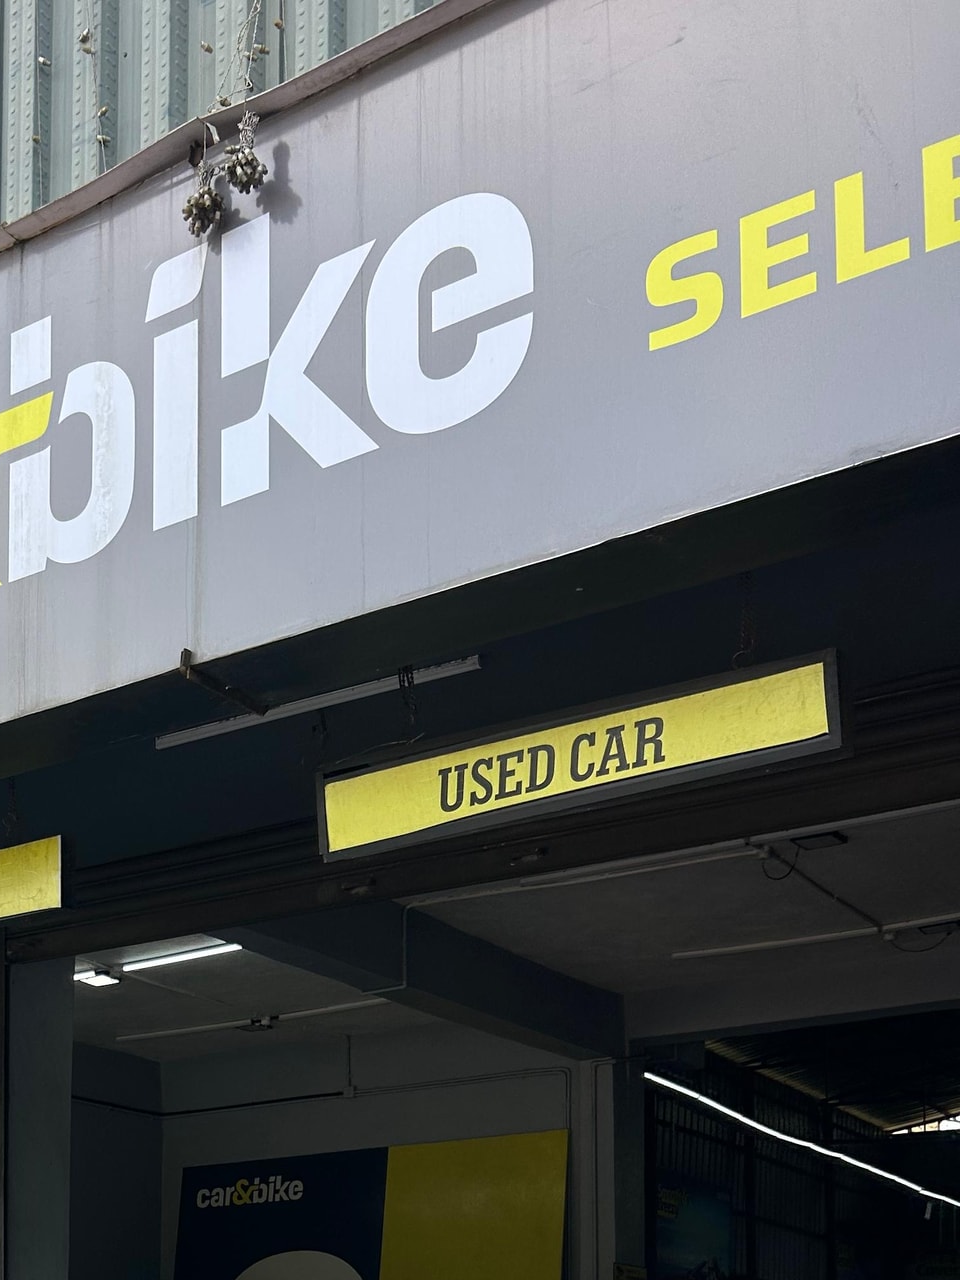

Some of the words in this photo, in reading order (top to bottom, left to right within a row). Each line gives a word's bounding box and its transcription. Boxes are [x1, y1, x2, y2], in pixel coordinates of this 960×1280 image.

[438, 744, 556, 814] USED
[570, 716, 666, 783] CAR
[196, 1175, 304, 1208] car&bike
